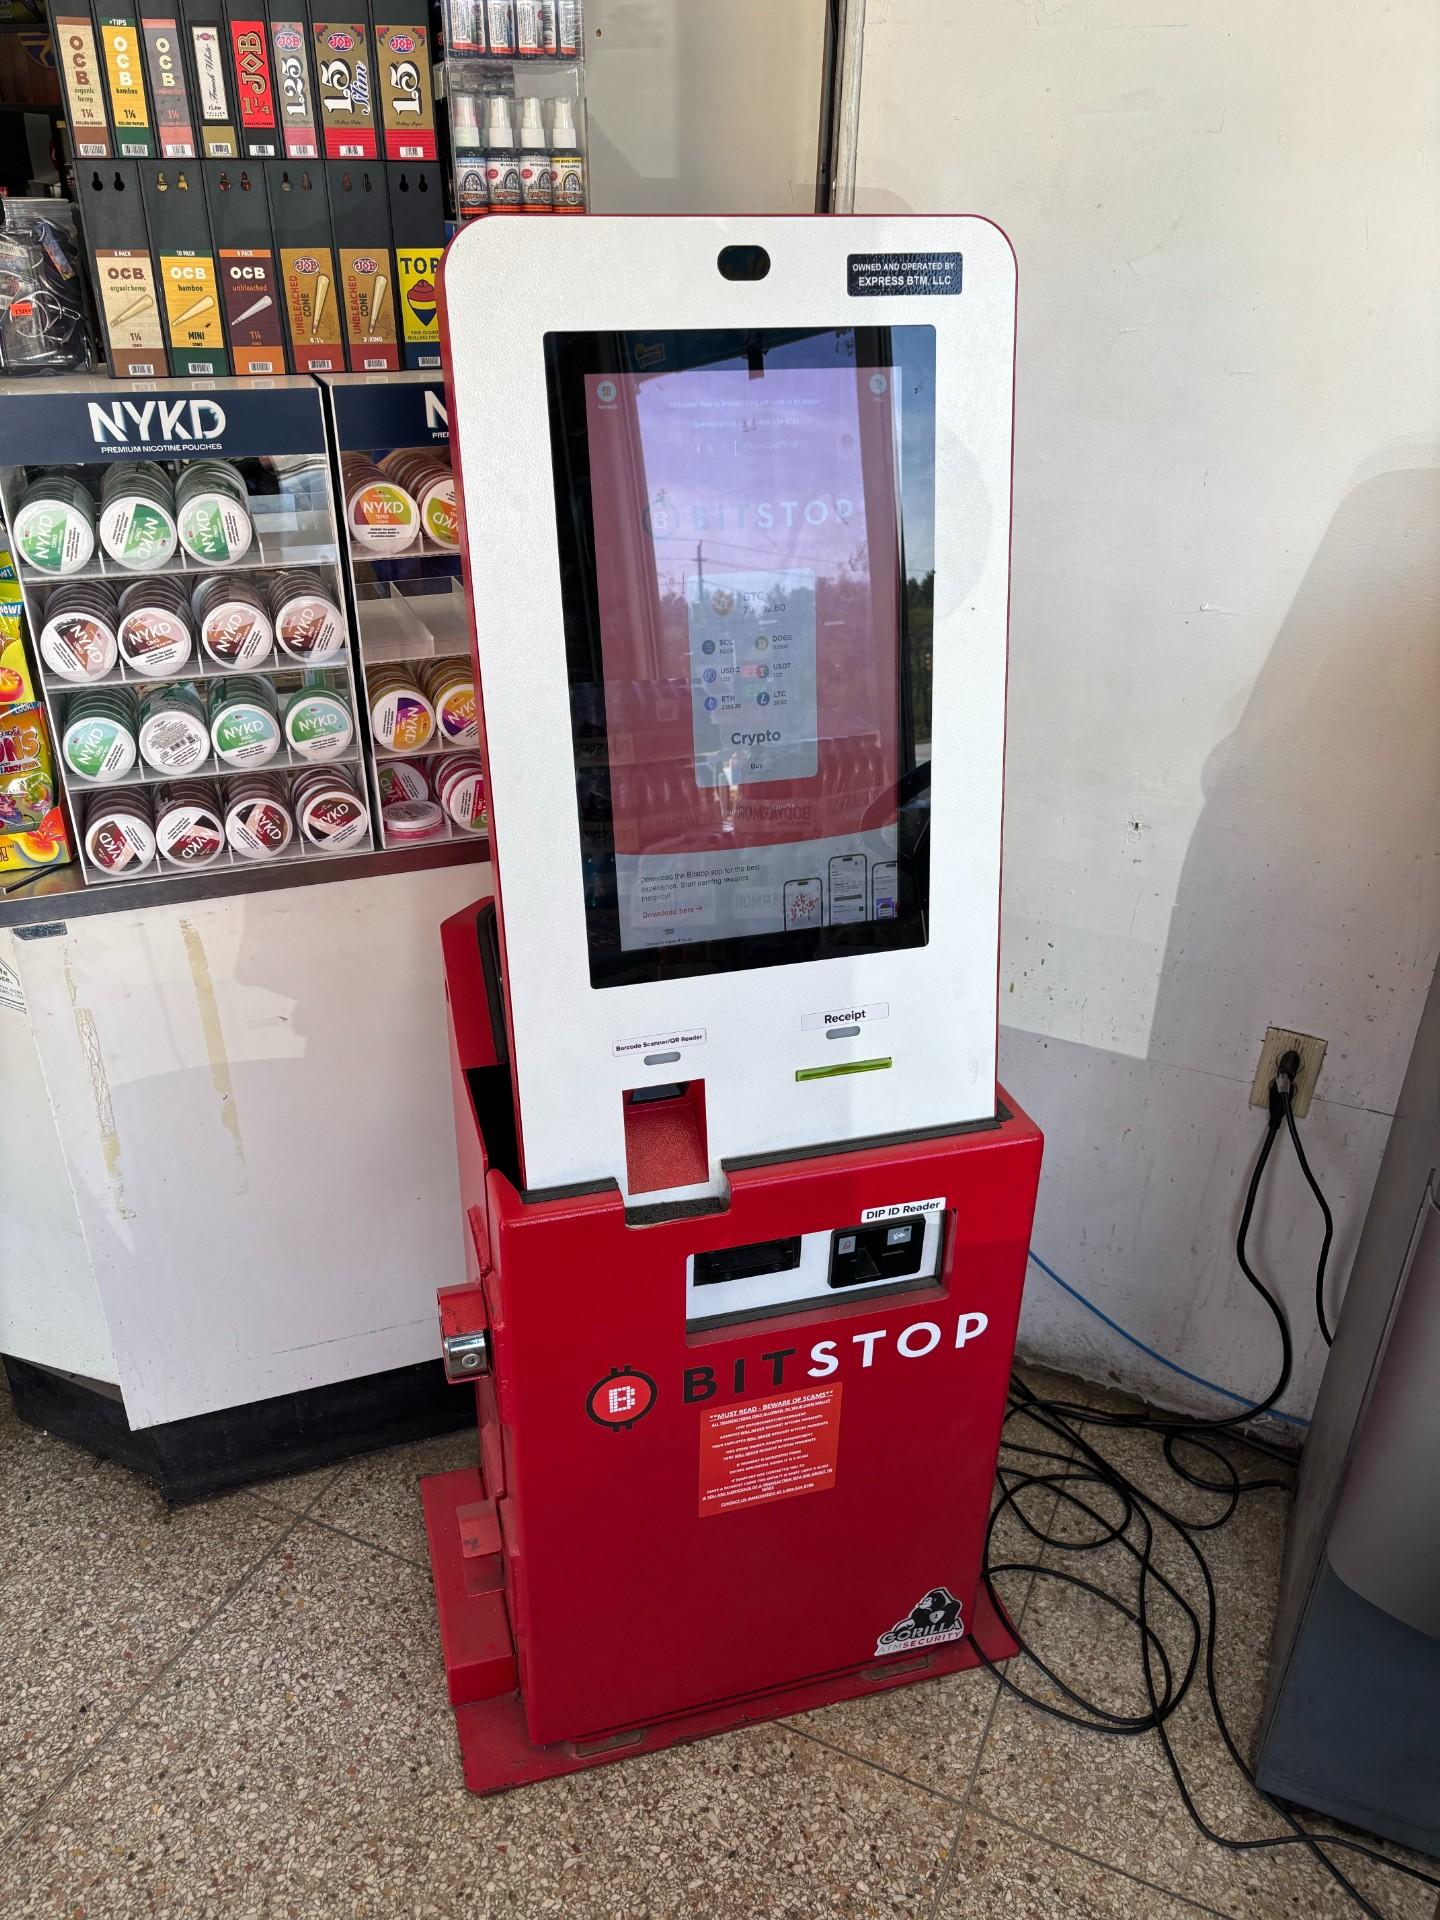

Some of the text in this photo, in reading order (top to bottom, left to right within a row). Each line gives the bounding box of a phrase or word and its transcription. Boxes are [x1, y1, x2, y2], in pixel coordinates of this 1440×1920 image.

[279, 36, 301, 48] JOB
[329, 36, 353, 49] JOB
[390, 38, 414, 50] JOB
[69, 35, 91, 86] OCB
[113, 36, 133, 87] OCB
[155, 37, 176, 87] OCB
[237, 31, 266, 95] JOB
[116, 87, 138, 95] bamboo
[107, 267, 145, 280] OCB
[170, 266, 207, 280] OCB
[230, 266, 266, 280] OCB
[296, 260, 319, 271] JOB
[355, 260, 378, 271] JOB
[852, 263, 881, 272] OWNED
[901, 262, 943, 270] OPERATED
[858, 276, 904, 286] EXPRESS
[932, 275, 951, 285] LLC
[289, 275, 305, 335] UNBLEACHED
[301, 293, 311, 318] CONE
[348, 275, 361, 335] UNBLEACHED
[358, 293, 369, 317] CONE
[188, 332, 205, 340] MINI
[87, 399, 226, 443] NYKD
[101, 446, 142, 454] PREMIUM
[363, 501, 404, 515] NYKD
[692, 498, 854, 531] BITSTOP
[35, 514, 54, 560] NYKD
[137, 516, 160, 560] NYKD
[195, 510, 217, 555] NYKD
[744, 592, 765, 602] BTC
[128, 622, 171, 646] NYKD
[216, 614, 243, 653] NYKD
[290, 608, 315, 647] NYKD
[70, 624, 104, 664] NYKD
[223, 720, 264, 741] NYKD
[298, 713, 338, 733] NYKD
[404, 706, 420, 744] NYKD
[76, 728, 104, 766] NYKD
[731, 729, 781, 746] Crypto
[640, 874, 673, 884] Download
[686, 870, 710, 879] Bitstop
[710, 868, 722, 877] app
[698, 878, 722, 887] earning
[643, 908, 678, 919] Download
[824, 1009, 867, 1025] Receipt
[615, 1034, 703, 1052] Barcode Scanner/QR Reader
[866, 1200, 941, 1220] DIP ID Reader
[683, 1311, 989, 1405] BITSTOP
[739, 1407, 757, 1415] READ
[762, 1400, 791, 1410] BEWARE
[880, 1619, 963, 1645] GORILLA
[902, 1631, 962, 1649] SECURITY
